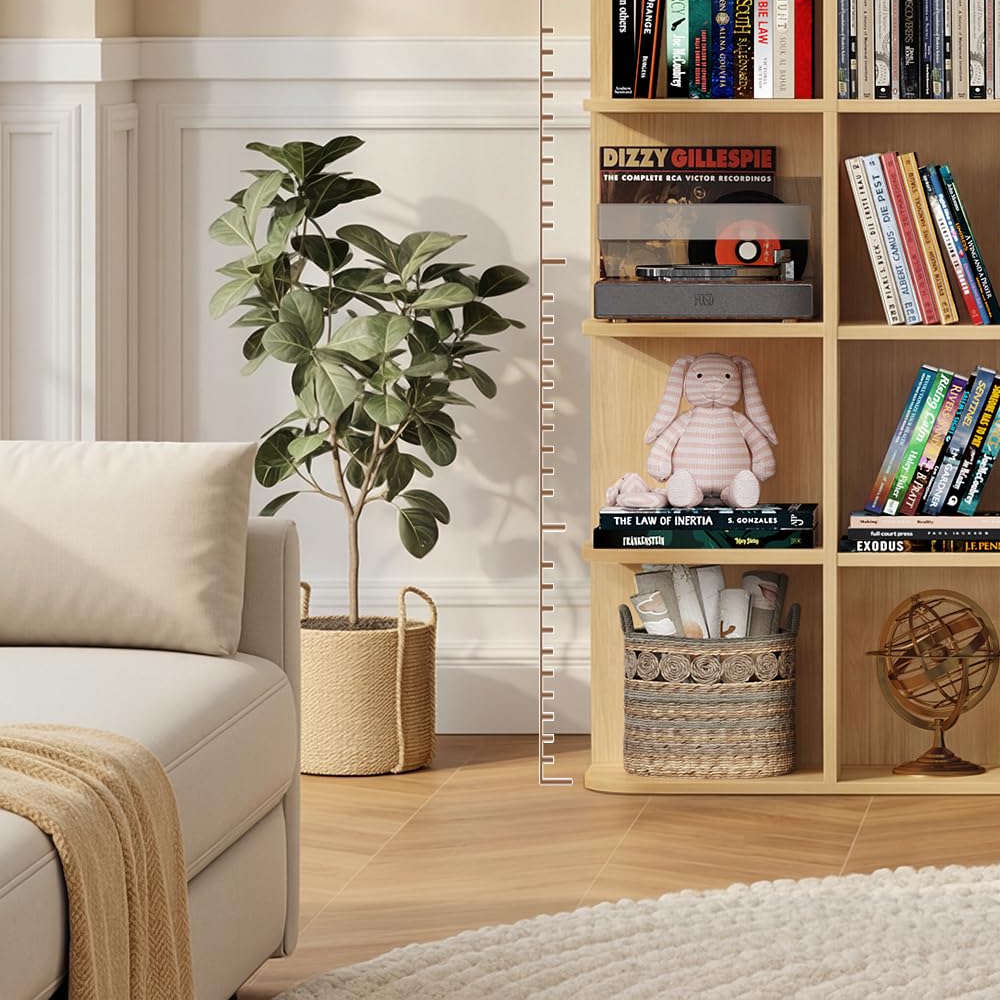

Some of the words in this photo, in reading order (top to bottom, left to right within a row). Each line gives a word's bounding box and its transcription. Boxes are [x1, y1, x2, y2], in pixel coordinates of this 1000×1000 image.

[619, 7, 628, 33] others
[758, 21, 768, 44] LAW
[604, 148, 668, 168] DIZZY
[671, 148, 773, 168] GILLESPIE
[872, 175, 881, 202] PEST
[880, 206, 889, 223] DIE
[886, 231, 898, 262] CAMUS
[897, 265, 909, 296] ALBERT
[614, 516, 632, 525] THE
[636, 516, 657, 525] LAW
[660, 516, 671, 525] OF
[675, 516, 713, 526] INERTIA
[623, 536, 665, 546] FRANKENSTEIN
[857, 541, 903, 551] EXODUS
